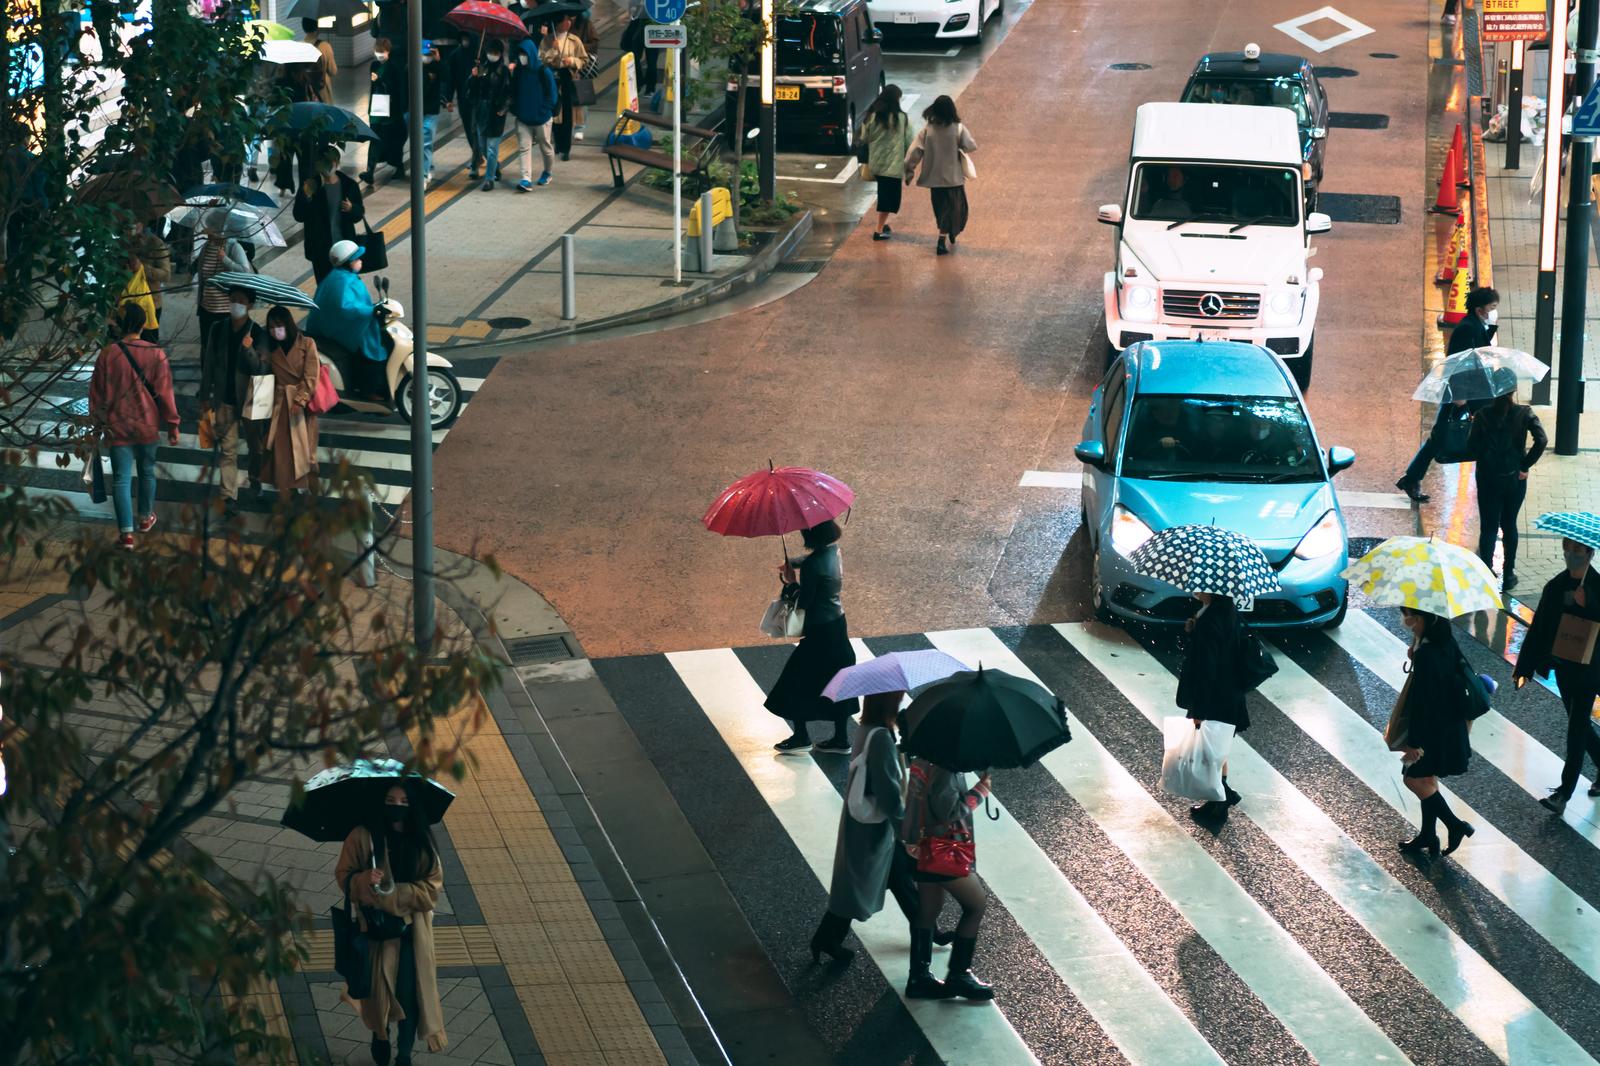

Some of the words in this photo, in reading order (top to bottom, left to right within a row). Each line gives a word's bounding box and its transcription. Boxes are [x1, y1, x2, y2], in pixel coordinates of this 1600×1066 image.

[654, 0, 670, 19] P
[1485, 0, 1519, 8] STREET
[665, 8, 677, 19] 40
